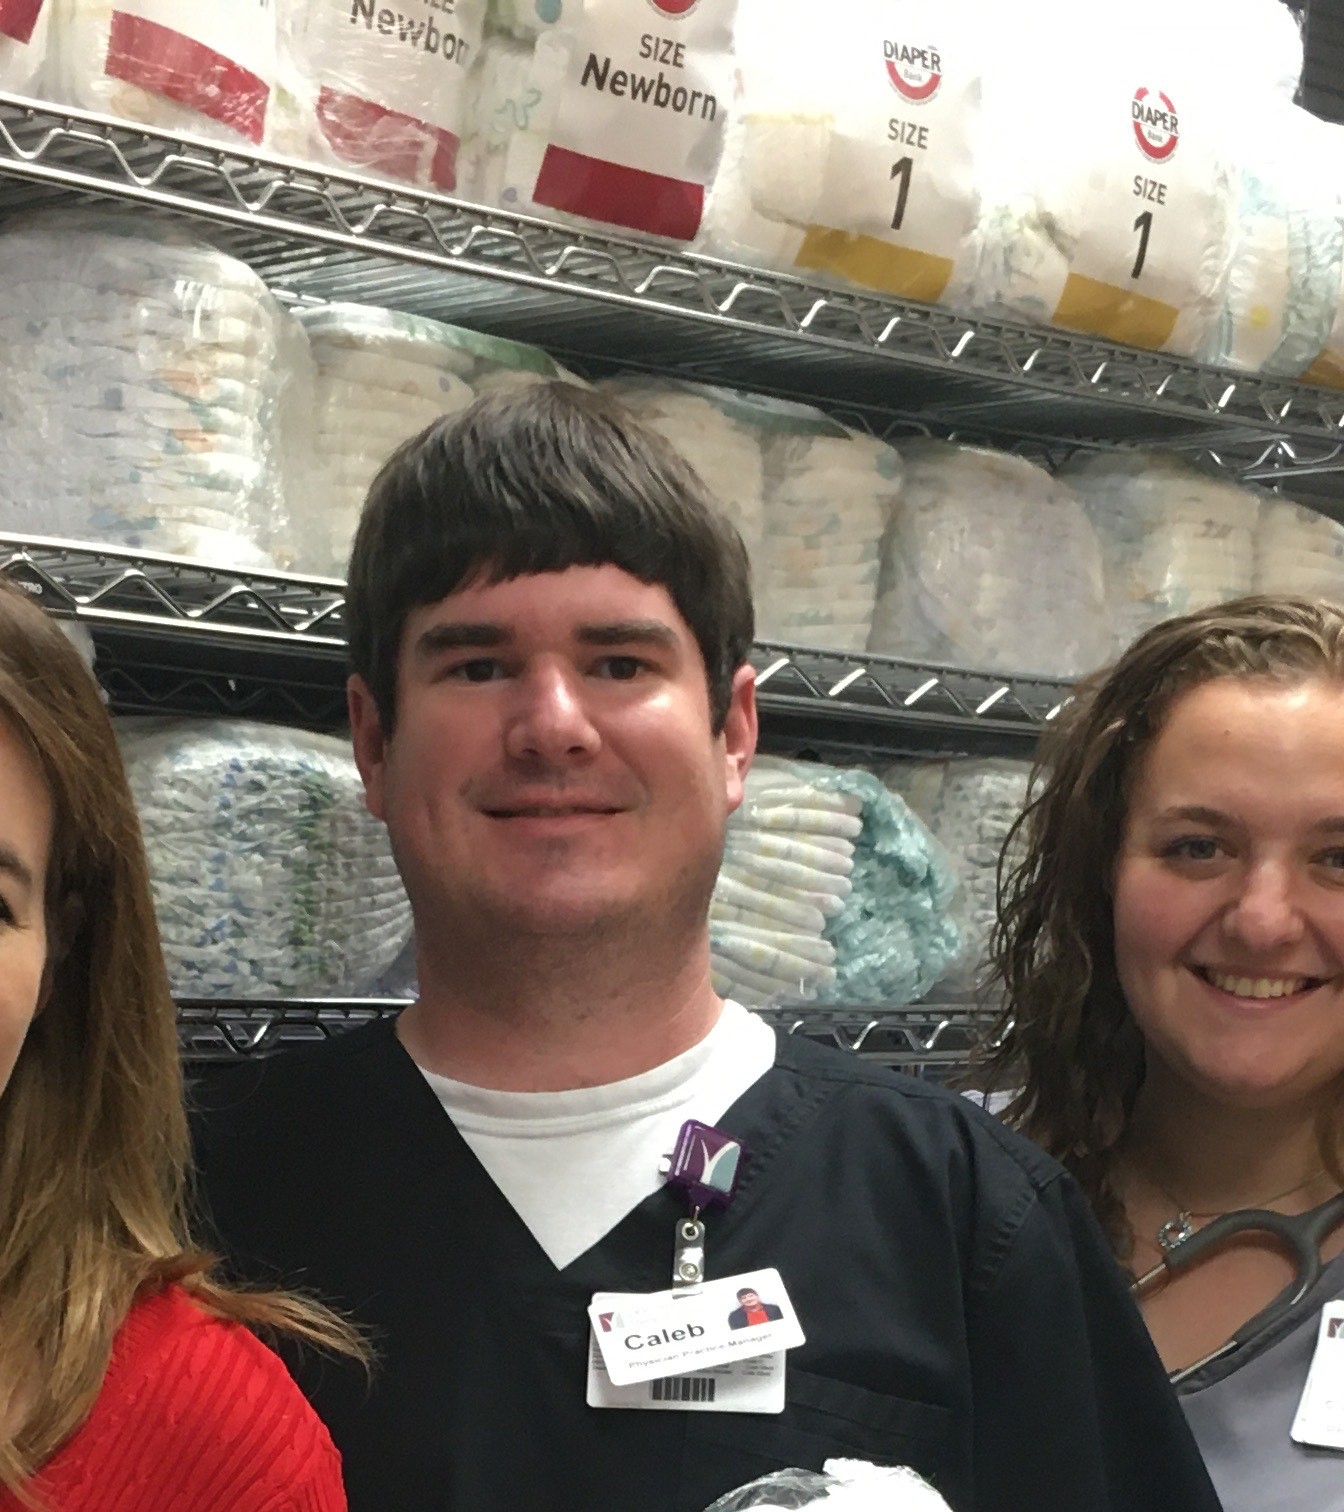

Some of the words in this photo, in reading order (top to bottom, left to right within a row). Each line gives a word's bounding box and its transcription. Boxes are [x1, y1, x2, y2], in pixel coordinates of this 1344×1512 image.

[640, 33, 686, 69] SIZE
[882, 39, 943, 74] DIAPER
[580, 52, 718, 123] Newborn
[887, 117, 929, 151] SIZE
[1130, 100, 1180, 135] DIAPER
[889, 155, 914, 231] 1
[1132, 174, 1168, 205] SIZE
[1131, 210, 1153, 280] 1
[624, 1323, 705, 1351] Caleb
